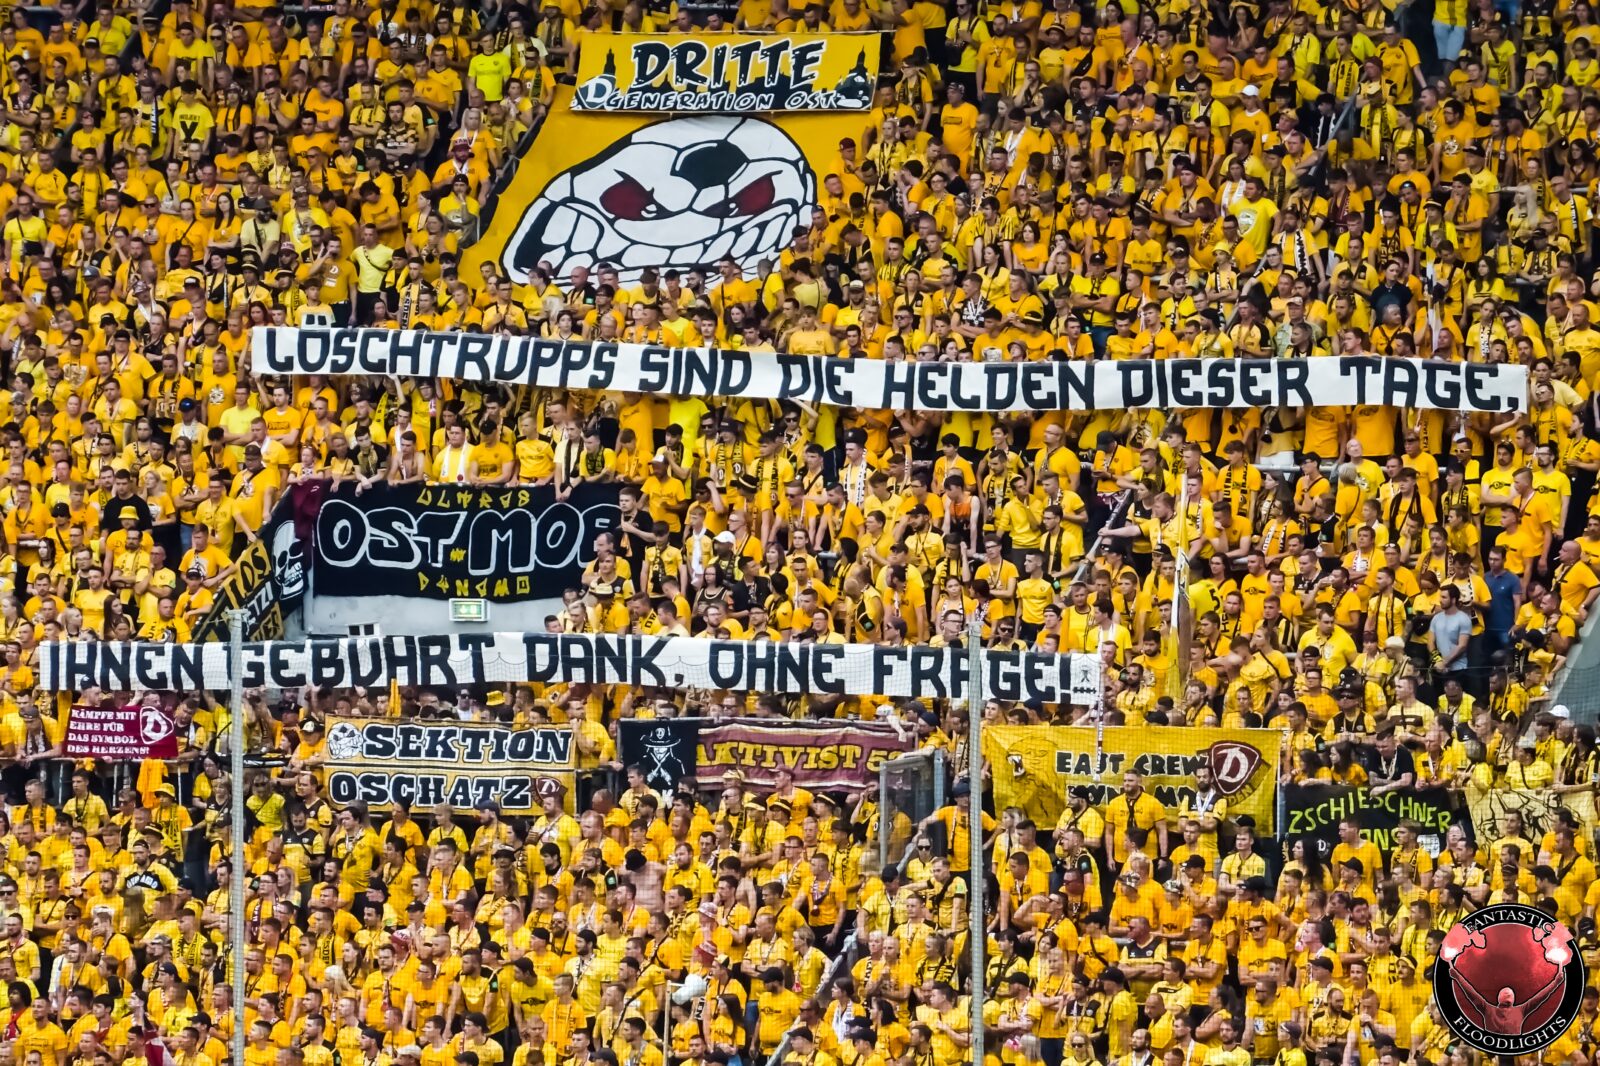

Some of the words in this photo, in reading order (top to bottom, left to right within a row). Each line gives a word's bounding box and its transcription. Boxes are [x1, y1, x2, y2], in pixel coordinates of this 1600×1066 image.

[631, 39, 827, 89] DRITTE
[604, 90, 778, 111] GENERATION
[785, 89, 838, 109] OST
[266, 313, 619, 390] LÖSCHTRUPPS
[639, 348, 752, 396] SIND
[777, 353, 855, 407] DIE
[882, 359, 1097, 411] HELDEN
[1117, 357, 1314, 408] DIESER
[1340, 355, 1519, 412] TAGE,
[416, 488, 531, 509] ULTRAS
[48, 640, 201, 691] IHNEN
[224, 622, 496, 690] GEBÜHRT
[522, 633, 685, 687] DANK,
[707, 638, 846, 695] OHNE
[873, 644, 1072, 704] FRAGE!
[69, 721, 101, 731] EHRE
[102, 721, 125, 732] FÜR
[71, 708, 115, 720] KÄMPFE
[115, 711, 137, 720] MIT
[67, 745, 90, 753] DES
[68, 732, 89, 742] DAS
[90, 733, 138, 744] SYMBOL
[363, 723, 573, 764] SEKTION
[694, 741, 861, 771] AKTIVIST
[329, 771, 532, 810] OSCHATZ
